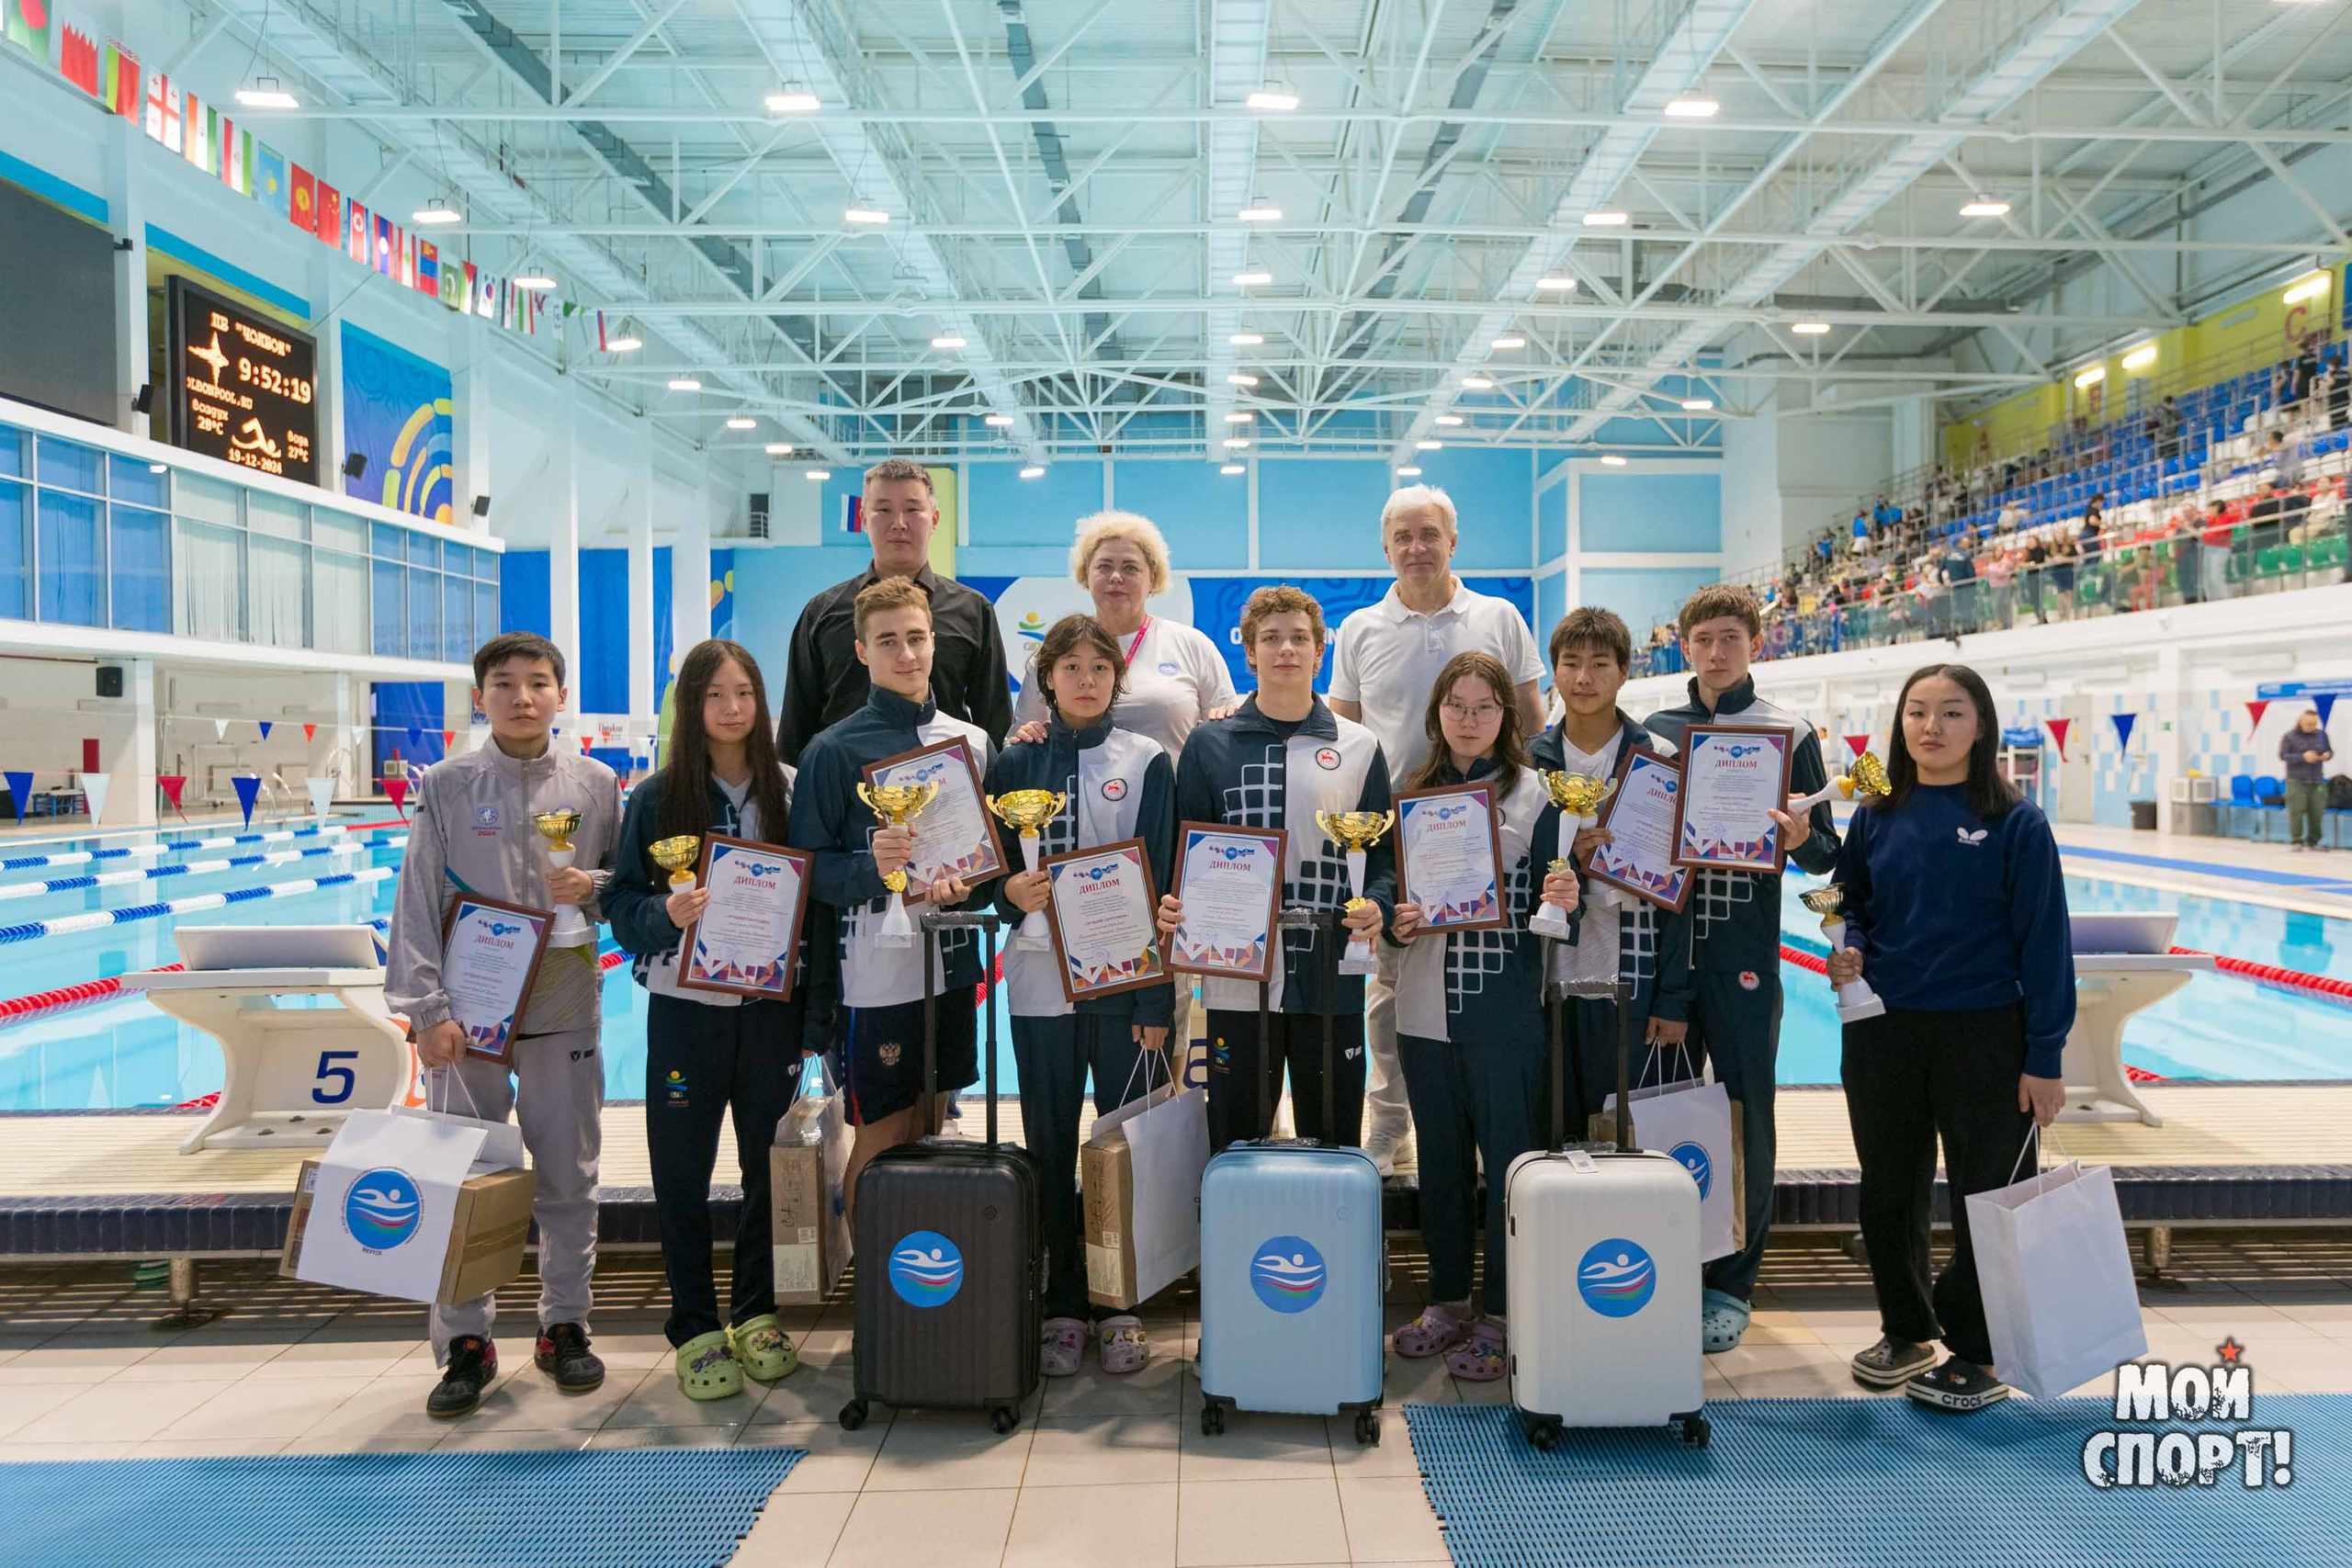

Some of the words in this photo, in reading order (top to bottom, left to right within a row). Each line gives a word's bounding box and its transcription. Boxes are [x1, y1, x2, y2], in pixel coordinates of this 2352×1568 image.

[210, 311, 229, 333] ПБ
[238, 356, 311, 404] 9:52:19
[228, 448, 283, 476] 19-12-2024
[1714, 759, 1758, 770] ДИПЛОМ
[1646, 787, 1678, 805] ДИПЛ
[1427, 820, 1467, 833] ДИПЛОМ
[1209, 860, 1250, 872] ДИПЛОМ
[733, 875, 776, 890] ДИПЛОМ
[1079, 878, 1120, 895] ДИПЛОМ
[473, 933, 514, 950] ДИПЛОМ
[311, 1051, 359, 1104] 5
[1941, 1393, 1983, 1407] crocs
